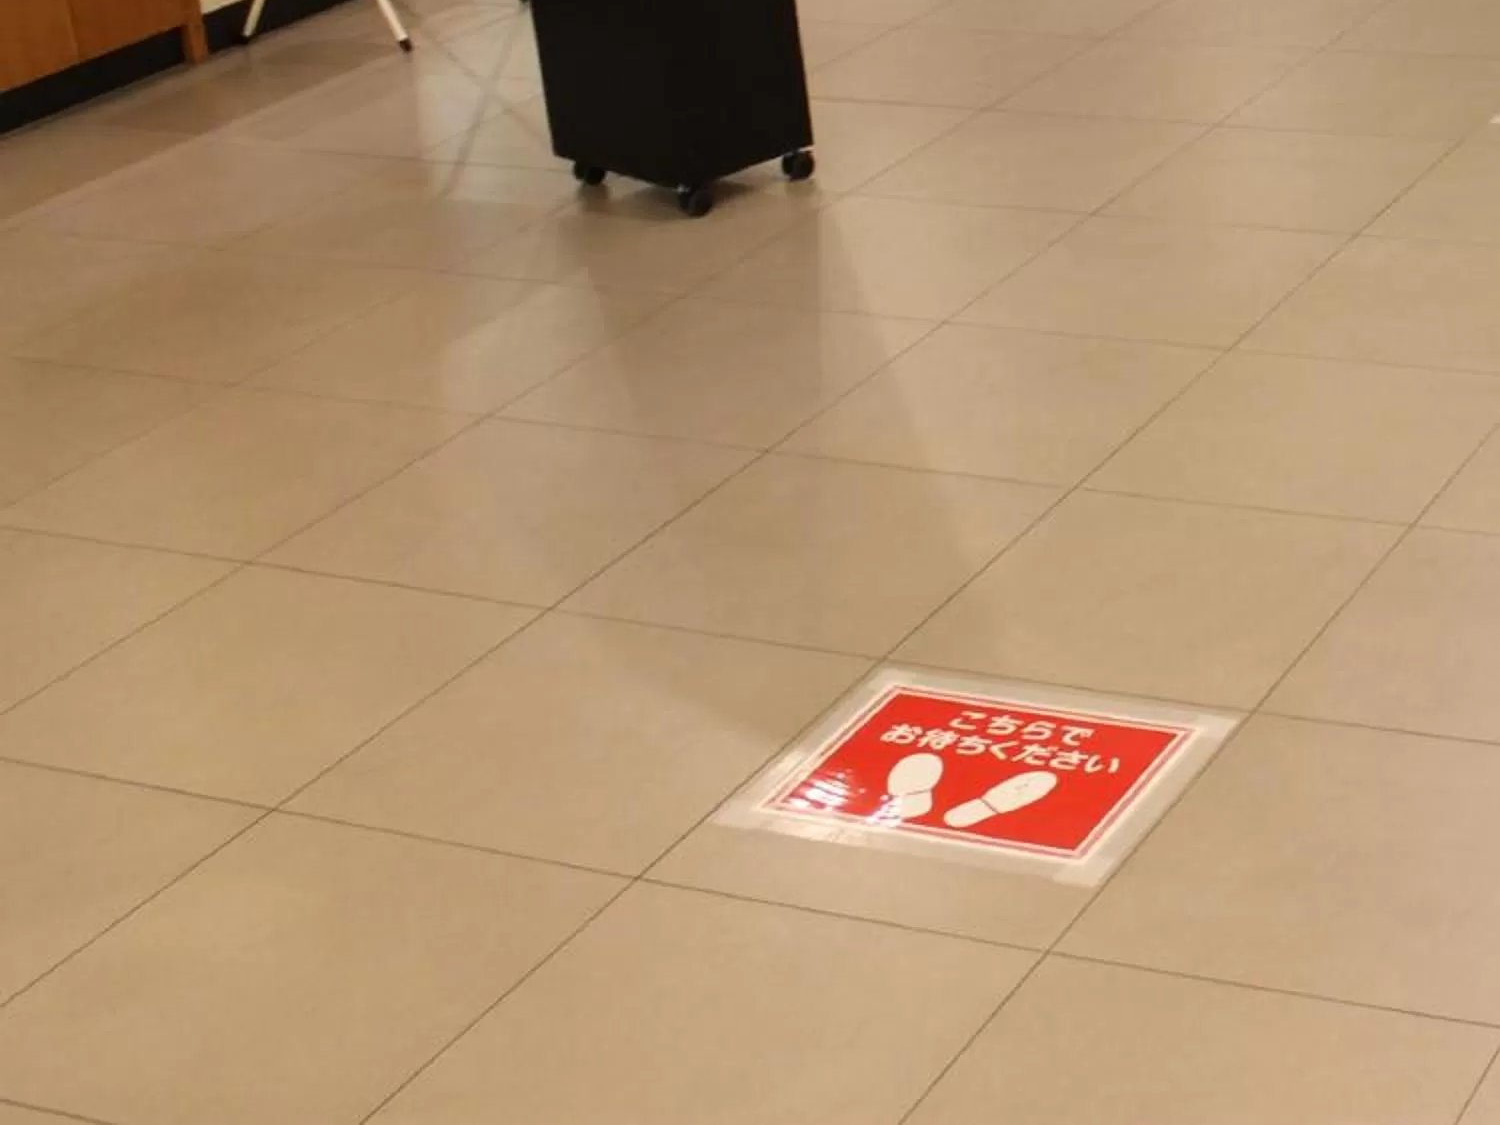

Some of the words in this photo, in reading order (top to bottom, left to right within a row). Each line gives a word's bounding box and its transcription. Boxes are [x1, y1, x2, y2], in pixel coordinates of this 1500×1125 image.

[880, 722, 1120, 774] お待ちください
[949, 710, 1095, 746] こちらで
